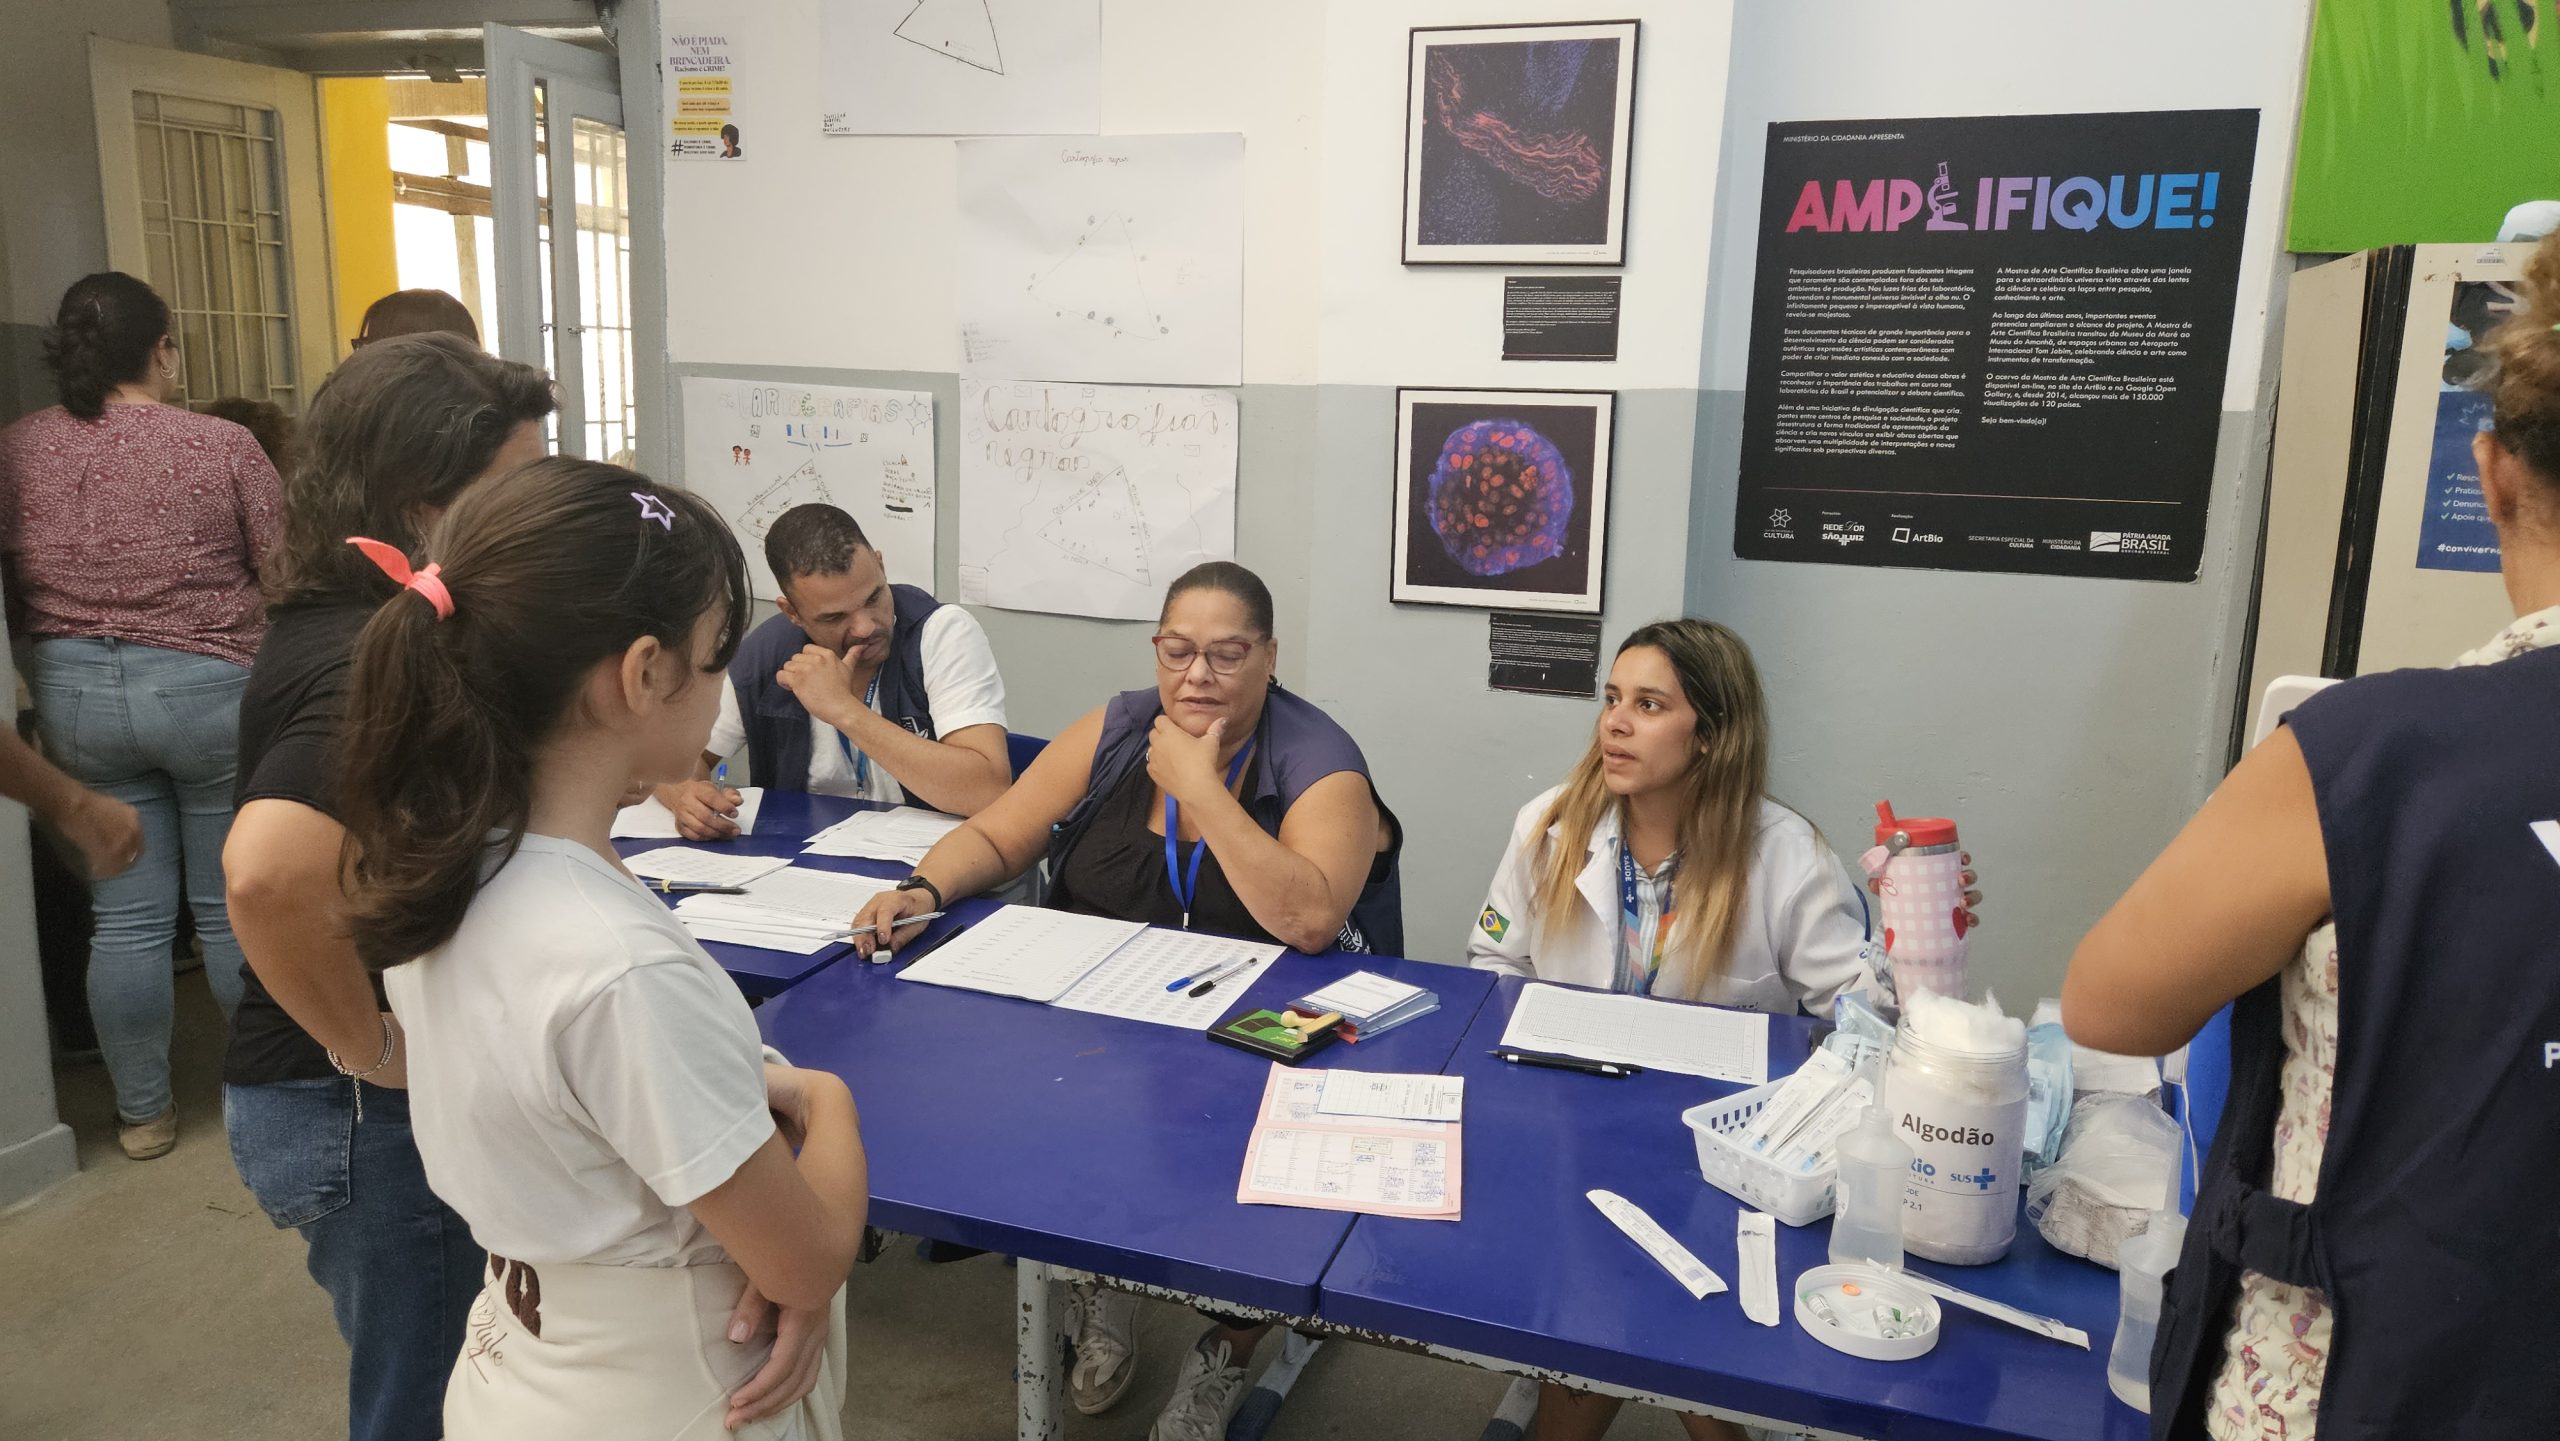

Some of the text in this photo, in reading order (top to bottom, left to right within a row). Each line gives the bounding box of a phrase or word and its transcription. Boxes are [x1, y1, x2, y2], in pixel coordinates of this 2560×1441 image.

[690, 46, 710, 55] NEM
[1831, 134, 1868, 142] CIDADANIA
[1868, 132, 1905, 141] APRESENTA
[2168, 267, 2192, 275] janela
[2077, 285, 2096, 293] laços
[2118, 285, 2152, 293] pesquisa,
[2004, 312, 2024, 320] longo
[2024, 338, 2055, 347] Amanhã,
[2140, 340, 2179, 348] Aeroporto
[2050, 348, 2074, 356] Jobim,
[2042, 356, 2095, 365] transformação.
[1985, 382, 2020, 390] disponível
[2125, 384, 2154, 393] Google
[2155, 384, 2177, 393] Open
[1984, 390, 2013, 399] Gallery,
[2046, 391, 2067, 400] 2014,
[2069, 392, 2100, 401] alcançou
[1983, 399, 2028, 408] visualizações
[1981, 416, 1997, 424] Seja
[1912, 533, 1944, 543] ArtBio
[2121, 539, 2170, 551] BRASIL
[1624, 855, 1632, 882] SAÚDE
[1902, 1113, 1994, 1145] Algodão
[1950, 1173, 1972, 1183] SUS
[1910, 1201, 1922, 1211] 2.1
